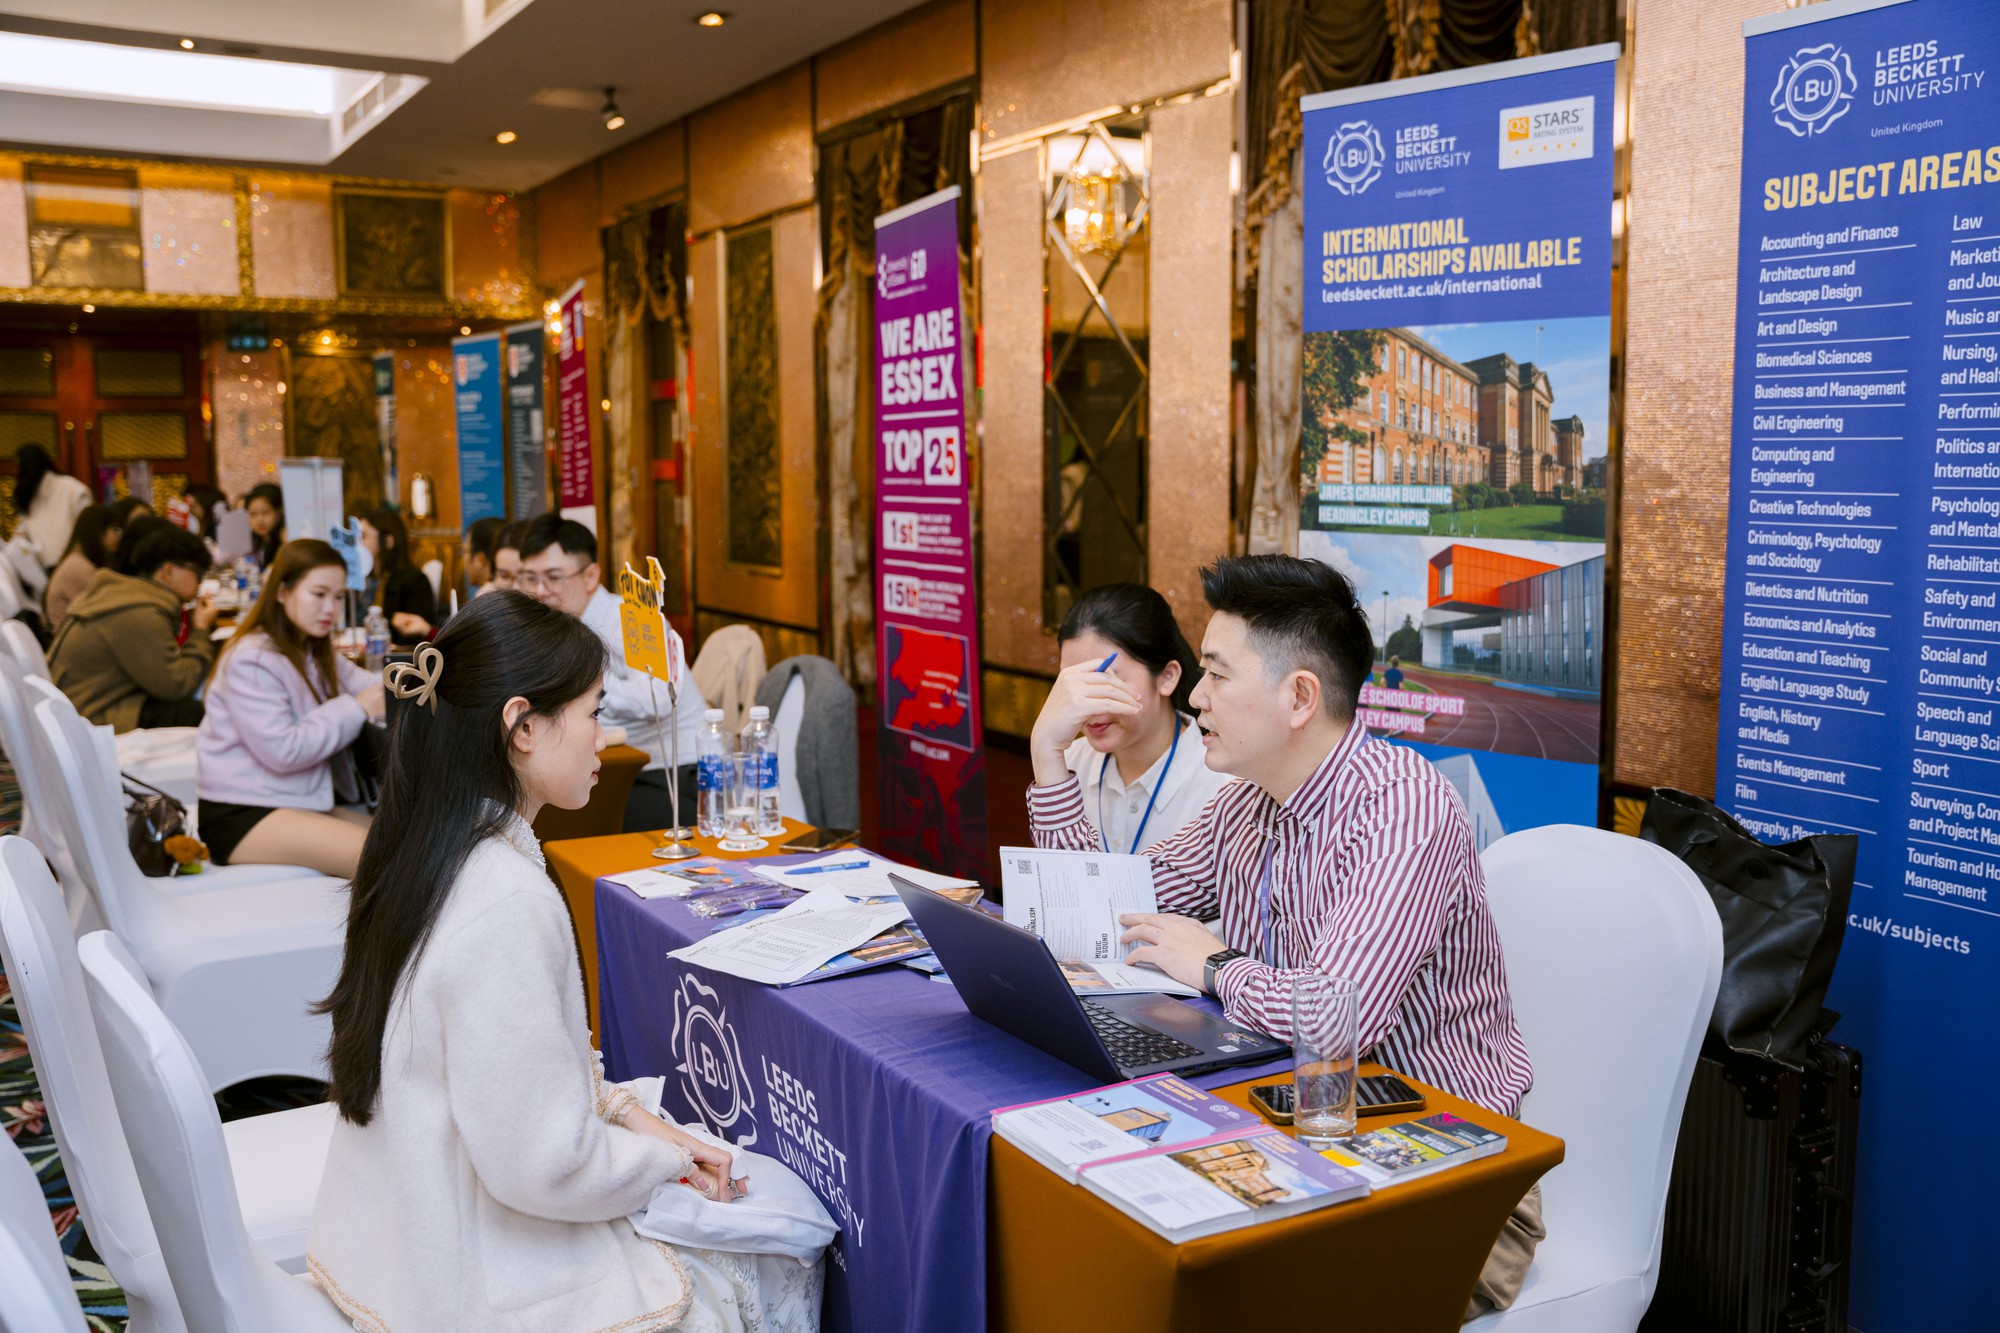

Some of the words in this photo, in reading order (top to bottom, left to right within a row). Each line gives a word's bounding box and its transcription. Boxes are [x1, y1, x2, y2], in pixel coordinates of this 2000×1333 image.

[1876, 40, 1937, 67] LEEDS
[1874, 54, 1964, 87] BECKETT
[1793, 79, 1832, 103] LBU
[1873, 71, 1985, 106] UNIVERSITY
[1508, 118, 1528, 135] QS
[1534, 109, 1580, 129] STARS
[1558, 125, 1584, 135] SYSTEM
[1871, 124, 1900, 138] United
[1902, 119, 1943, 134] Kingdom
[1396, 124, 1439, 144] LEEDS
[1340, 149, 1368, 169] LBU
[1395, 137, 1457, 159] BECKETT
[1395, 151, 1472, 175] UNIVERSITY
[1764, 161, 1895, 211] SUBJECT
[1899, 146, 2000, 195] AREAS
[1395, 189, 1416, 199] United
[1417, 186, 1445, 198] Kingdom
[1953, 215, 1983, 231] Law
[1323, 217, 1469, 256] INTERNATIONAL
[1761, 232, 1824, 252] Accounting
[1826, 228, 1849, 245] and
[1851, 225, 1899, 242] Finance
[1322, 248, 1465, 284] SCHOLARSHIPS
[1468, 237, 1582, 274] AVAILABLE
[1759, 263, 1830, 283] Architecture
[1832, 260, 1856, 276] and
[1322, 273, 1542, 303] leedsbeckett.ac.uk/international
[1758, 287, 1819, 305] Landscape
[1821, 283, 1862, 301] Design
[1948, 274, 1974, 291] and
[1757, 320, 1774, 337] Art
[1775, 319, 1797, 335] and
[1798, 318, 1838, 336] Design
[1946, 308, 1984, 326] Music
[880, 317, 912, 358] WE
[912, 307, 956, 354] ARE
[1756, 350, 1816, 368] Biomedical
[1817, 349, 1872, 365] Sciences
[1943, 343, 1998, 363] Nursing,
[881, 353, 958, 406] ESSEX
[1941, 369, 1967, 385] and
[1755, 383, 1804, 400] Business
[1806, 382, 1828, 398] and
[1830, 381, 1906, 400] Management
[1753, 415, 1775, 431] Civil
[1776, 414, 1844, 433] Engineering
[882, 429, 923, 473] TOP
[929, 437, 957, 477] 25
[1752, 447, 1810, 465] Computing
[1812, 447, 1835, 462] and
[1936, 438, 1984, 454] Politics
[1751, 468, 1815, 487] Engineering
[1319, 485, 1354, 502] JAMES
[1355, 486, 1400, 503] GRAHAM
[1402, 487, 1452, 504] BUILDING
[1319, 508, 1384, 525] HEADINGLEY
[1386, 509, 1429, 526] CAMPUS
[1749, 499, 1794, 515] Creative
[1796, 500, 1871, 521] Technologies
[890, 519, 915, 545] 1st
[1748, 529, 1813, 551] Criminology,
[1815, 532, 1882, 554] Psychology
[1930, 521, 1955, 537] and
[1957, 521, 2000, 538] Mental
[1747, 552, 1767, 567] and
[1768, 552, 1821, 573] Sociology
[1745, 581, 1793, 599] Dietetics
[1794, 584, 1814, 600] and
[1817, 586, 1869, 605] Nutrition
[1925, 588, 1969, 610] Safety
[1971, 592, 1996, 608] and
[1744, 611, 1800, 632] Economics
[1802, 619, 1823, 633] and
[1824, 619, 1876, 639] Analytics
[1742, 642, 1795, 662] Education
[1796, 648, 1818, 665] and
[1820, 651, 1871, 673] Teaching
[1921, 645, 1961, 664] Social
[1963, 651, 1987, 667] and
[1741, 673, 1778, 693] English
[1780, 677, 1834, 701] Language
[1836, 684, 1870, 706] Study
[1919, 668, 1994, 695] Community
[1369, 688, 1411, 709] SCHOOL
[1411, 693, 1425, 710] OF
[1426, 696, 1465, 716] SPORT
[1917, 702, 1965, 723] Speech
[1967, 709, 1992, 726] and
[1382, 712, 1425, 733] CAMPUS
[1739, 703, 1780, 725] English,
[1781, 708, 1821, 731] History
[1738, 726, 1757, 741] and
[1759, 727, 1790, 745] Media
[1915, 725, 1978, 751] Language
[1737, 753, 1772, 773] Events
[1774, 760, 1846, 786] Management
[1913, 758, 1950, 779] Sport
[1735, 783, 1757, 801] Film
[1911, 791, 1975, 820] Surveying,
[1909, 817, 1933, 832] and
[1935, 818, 1978, 841] Project
[1907, 847, 1958, 872] Tourism
[1959, 861, 1984, 878] and
[1905, 870, 1987, 902] Management
[1846, 913, 1970, 955] c.uk/subjects
[692, 1042, 730, 1091] LBU
[761, 1054, 819, 1125] LEEDS
[770, 1092, 847, 1186] BECKETT
[776, 1132, 865, 1248] UNIVERSITY
